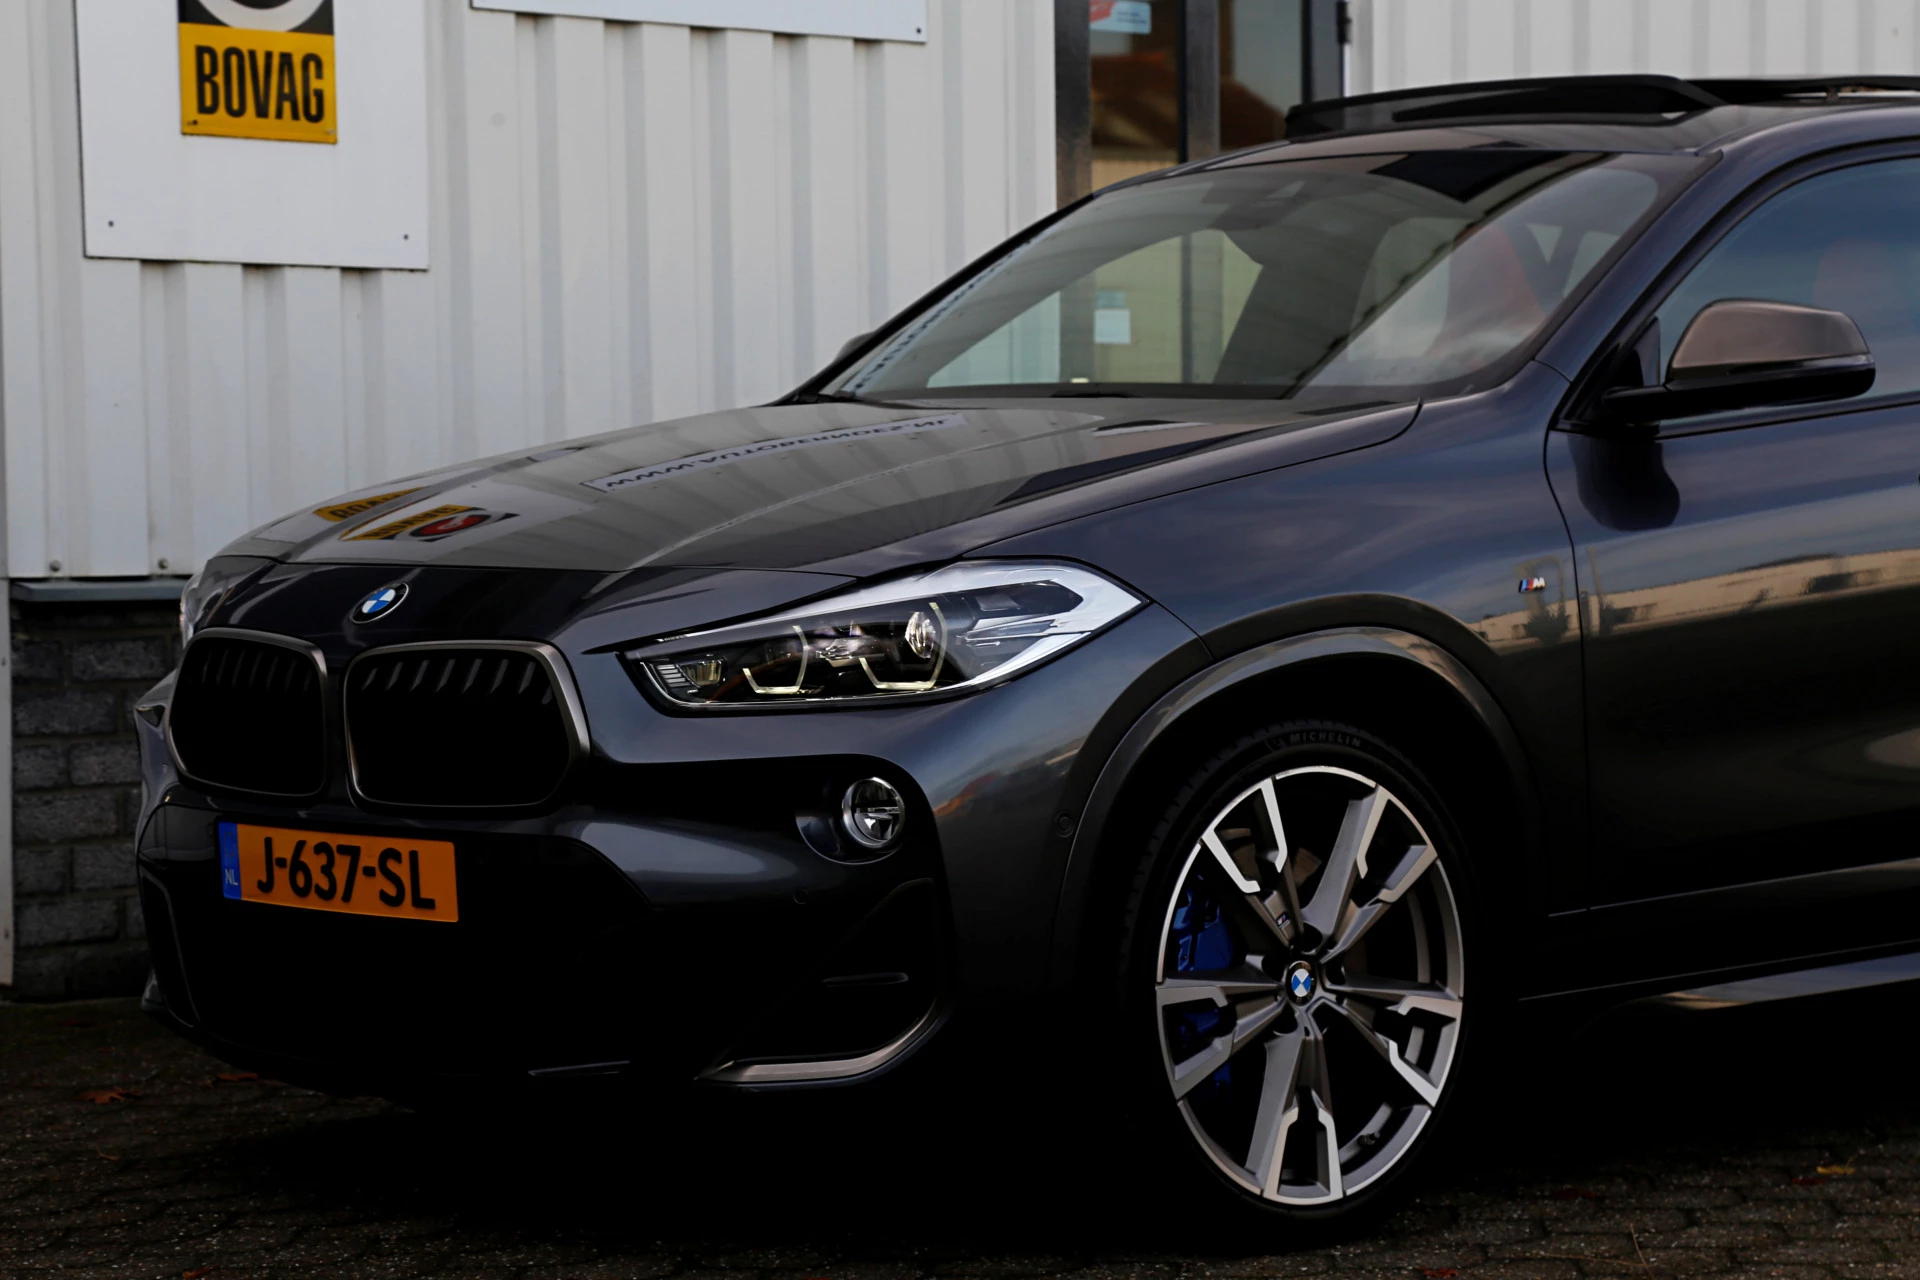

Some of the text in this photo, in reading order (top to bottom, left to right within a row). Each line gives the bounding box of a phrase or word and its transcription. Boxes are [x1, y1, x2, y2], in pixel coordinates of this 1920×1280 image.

[195, 45, 324, 124] BOVAG
[1290, 731, 1361, 747] MICHELIN
[225, 868, 239, 886] NL
[257, 836, 436, 910] J-637-SL
